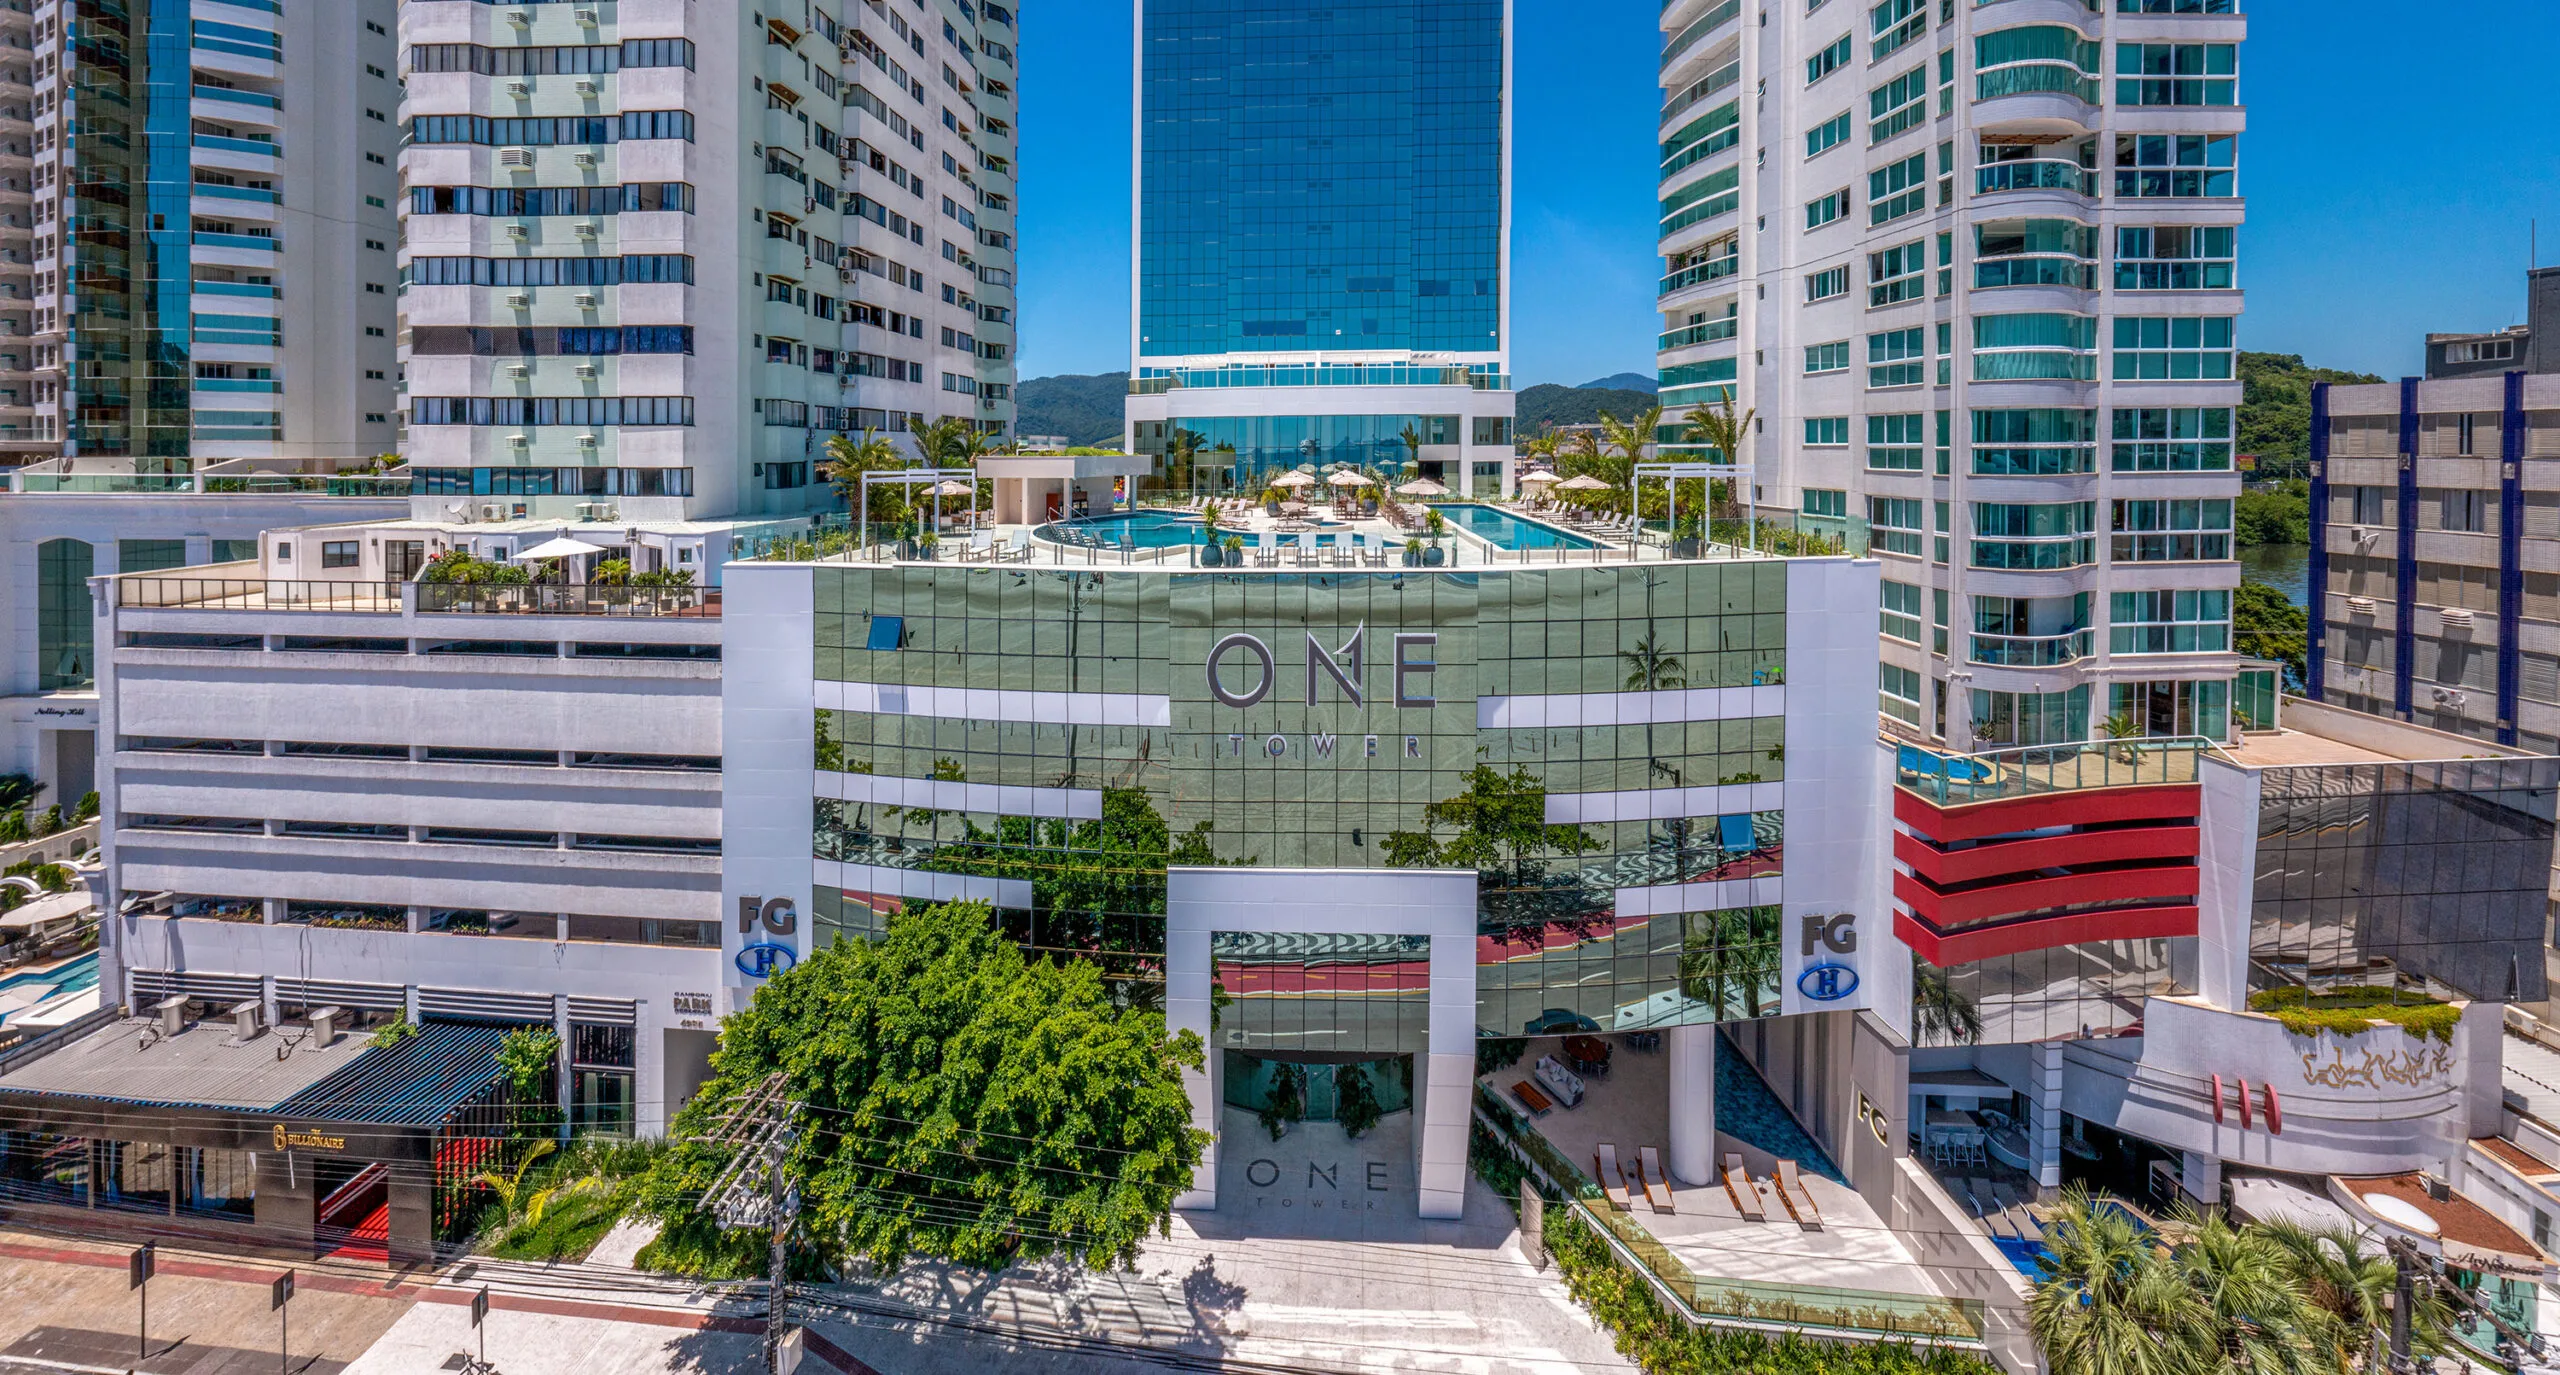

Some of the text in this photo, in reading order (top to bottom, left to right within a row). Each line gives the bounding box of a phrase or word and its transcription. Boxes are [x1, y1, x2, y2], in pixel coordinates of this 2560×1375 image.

[1206, 618, 1438, 712] ONE
[1228, 731, 1422, 760] TOWER
[739, 896, 796, 935] FG
[1801, 912, 1857, 956] FG
[674, 997, 712, 1010] PARK
[1858, 1090, 1888, 1149] FG
[287, 1134, 346, 1150] BILLIONAIRE
[1246, 1158, 1389, 1192] ONE
[1256, 1197, 1375, 1211] TOWER
